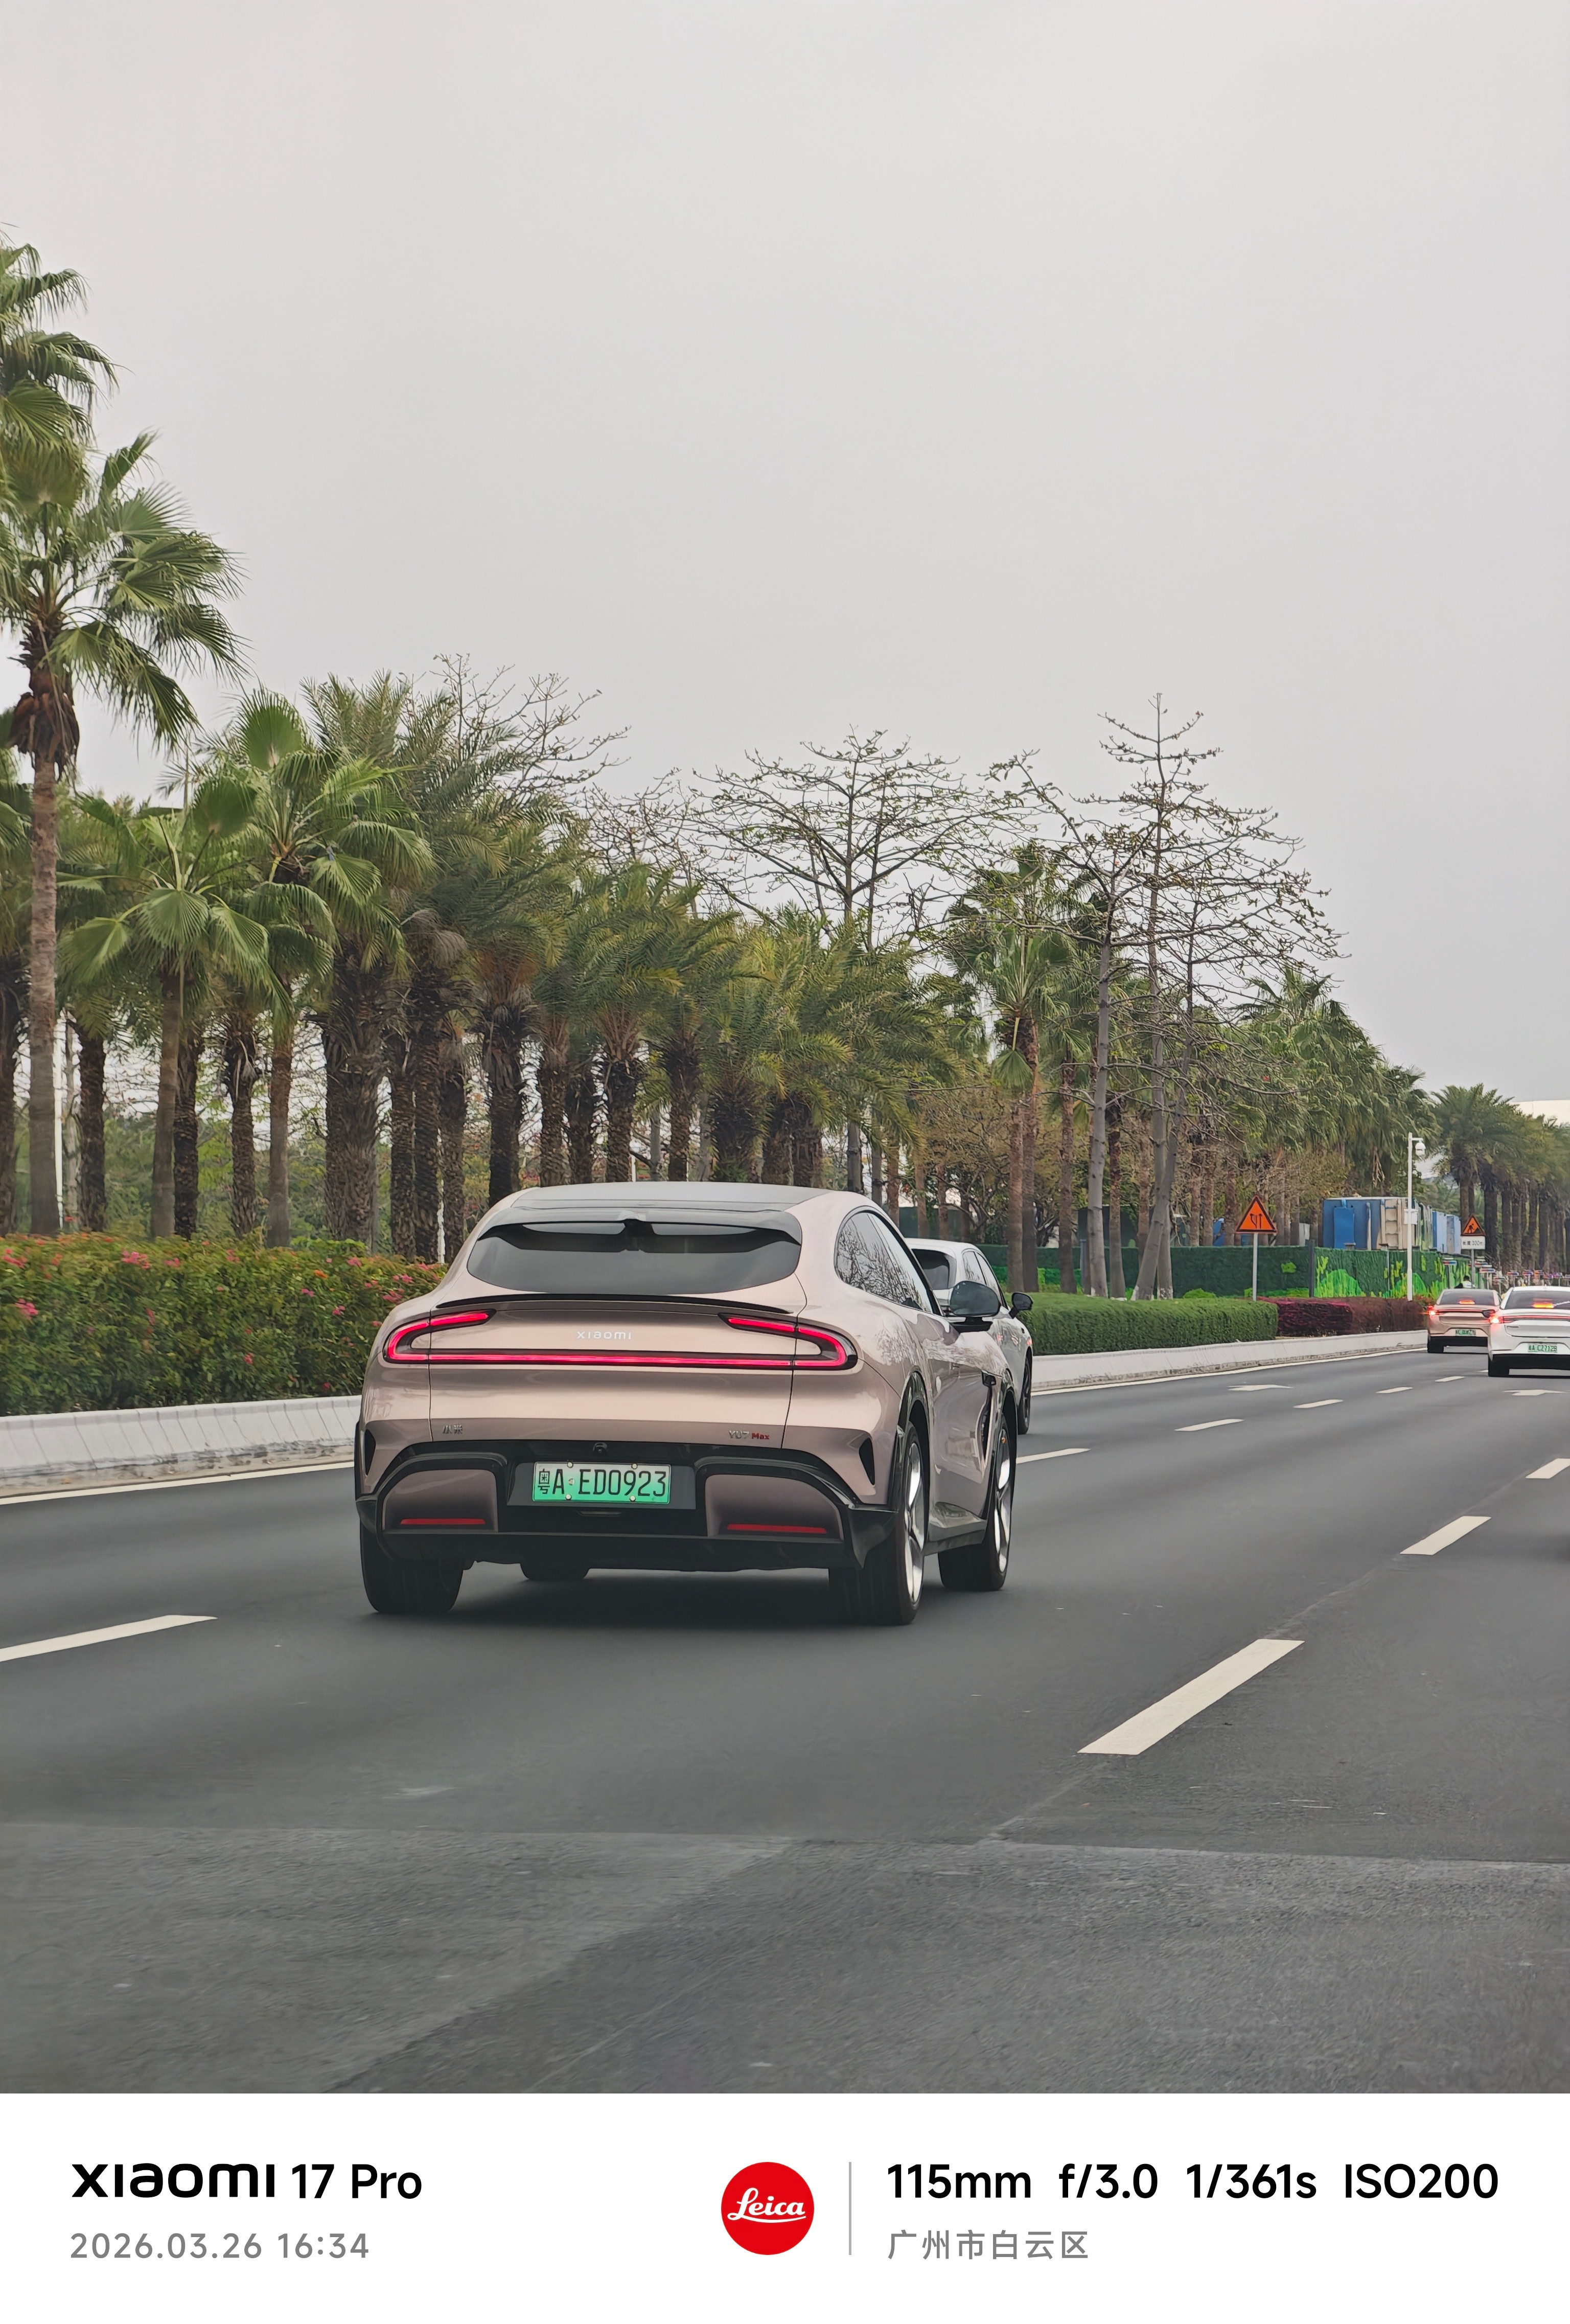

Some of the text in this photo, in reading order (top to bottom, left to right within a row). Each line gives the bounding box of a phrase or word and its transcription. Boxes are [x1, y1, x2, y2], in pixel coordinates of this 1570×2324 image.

[576, 1331, 631, 1340] xiaomi
[442, 1424, 463, 1434] 小米
[729, 1430, 750, 1439] YU7
[578, 1468, 667, 1497] ED0923
